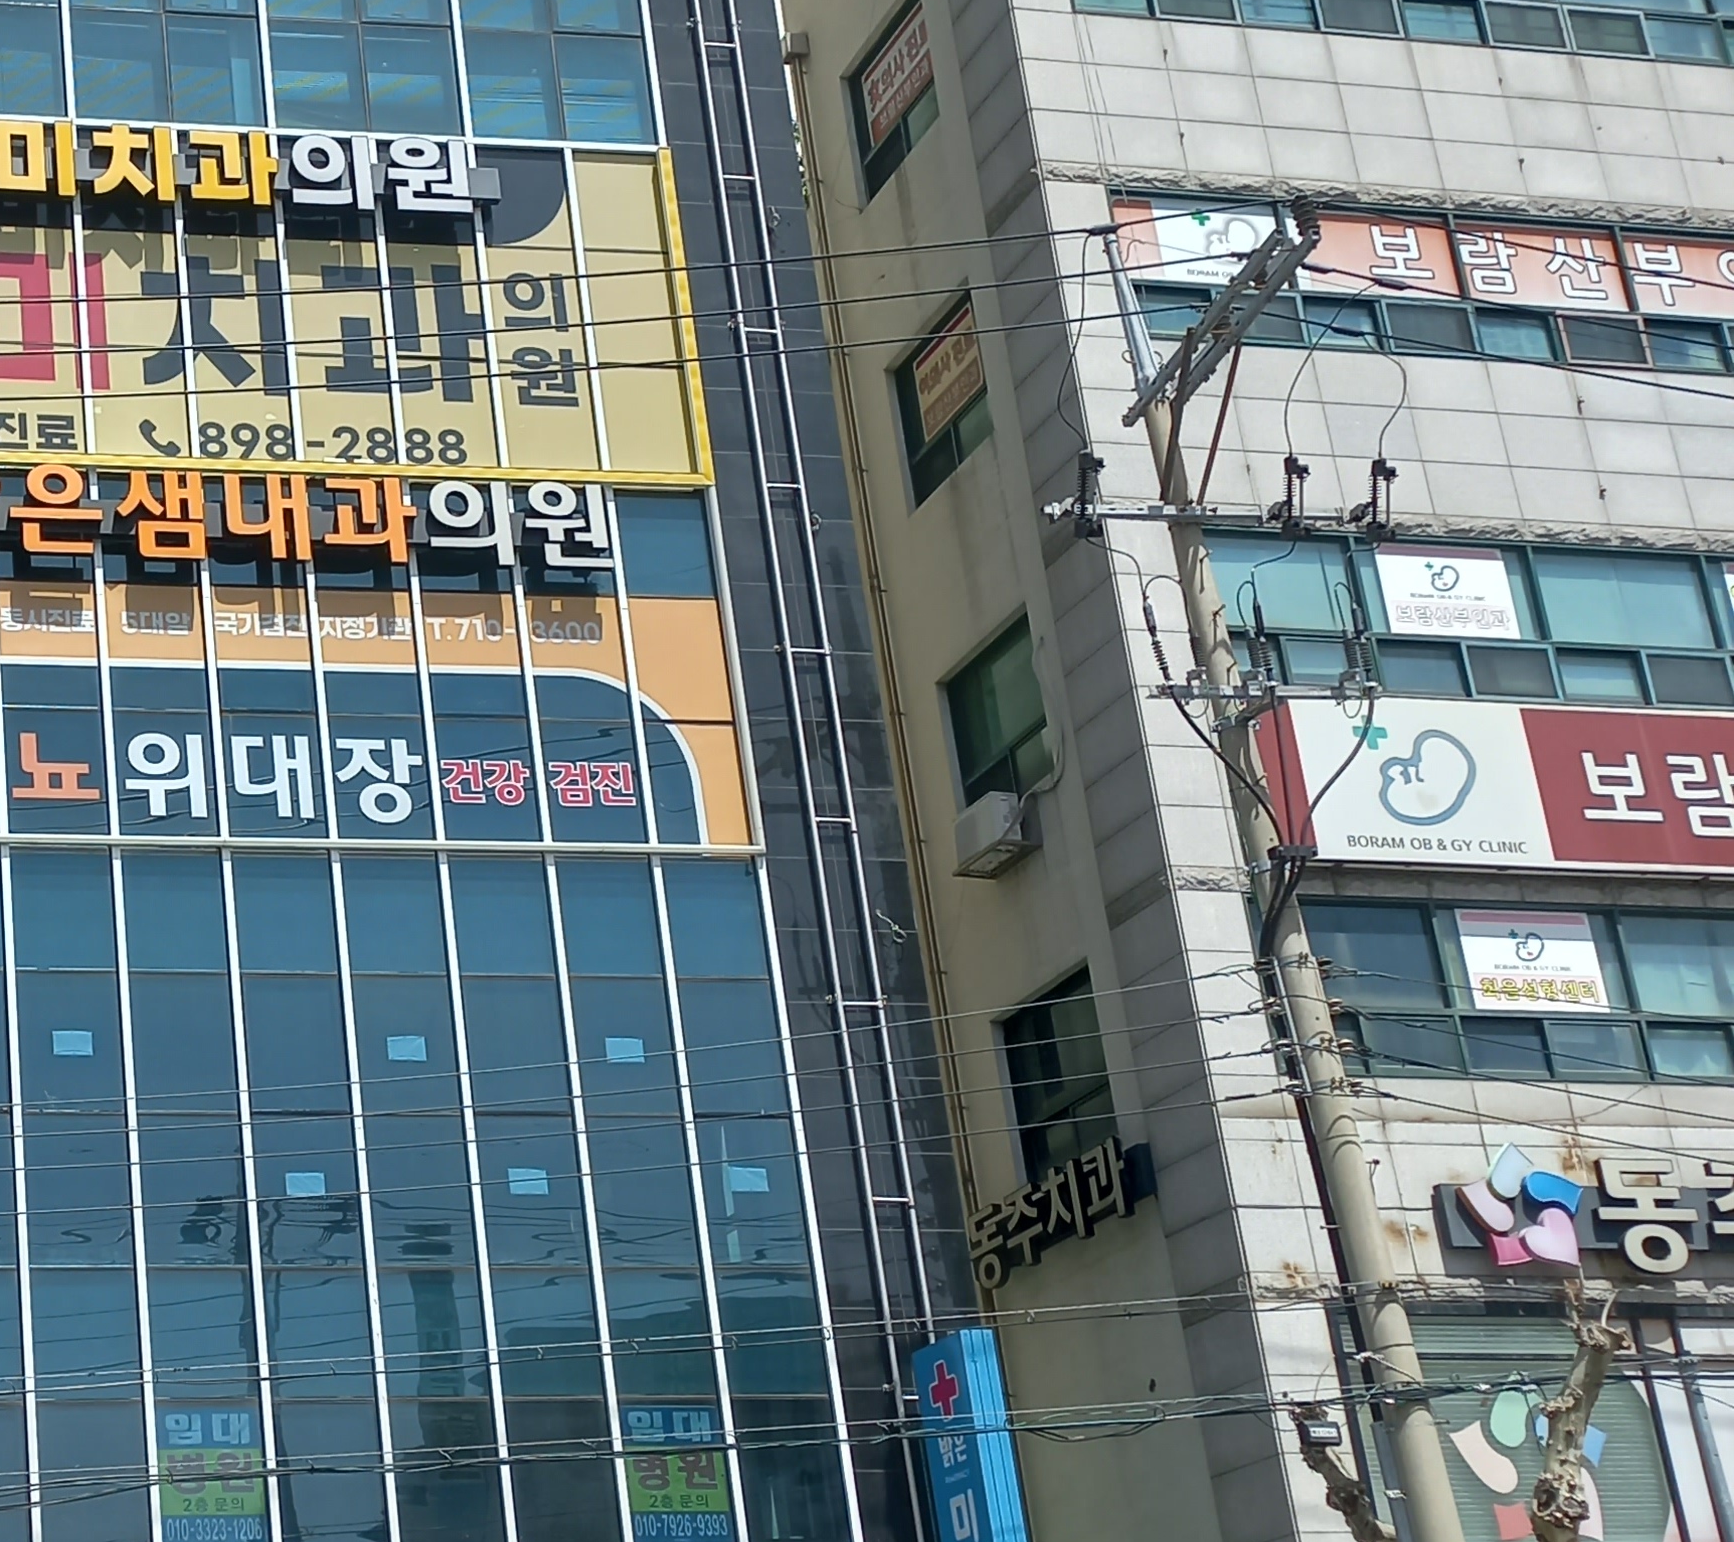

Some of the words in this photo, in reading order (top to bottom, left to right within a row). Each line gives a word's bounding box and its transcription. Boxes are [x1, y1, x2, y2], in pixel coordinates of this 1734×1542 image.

[503, 270, 580, 408] 의원
[199, 422, 468, 465] 898-2888
[0, 607, 97, 635] 동시진료
[120, 611, 191, 636] 5대암
[214, 612, 308, 637] 국가검진
[319, 614, 412, 640] 지정기관
[1395, 605, 1510, 631] 보람산부인과
[124, 731, 423, 825] 위대장
[441, 759, 531, 807] 건강
[548, 760, 637, 808] 검진
[1580, 751, 1734, 838] 보람
[1347, 833, 1406, 851] BORAM
[1410, 836, 1434, 851] OB
[1437, 837, 1448, 852] &
[1450, 838, 1473, 853] GY
[1479, 839, 1529, 855] CLINIC
[968, 1135, 1125, 1289] 동주치과
[166, 1413, 251, 1445] 임대
[627, 1411, 712, 1443] 임대
[166, 1452, 255, 1495] 병원
[632, 1450, 718, 1491] 병원
[182, 1498, 209, 1512] 2층
[214, 1497, 245, 1512] 문의
[650, 1494, 673, 1509] 2층
[680, 1494, 710, 1509] 문의
[166, 1517, 264, 1542] 010-3323-1206
[635, 1514, 729, 1537] 010-7926-9393
